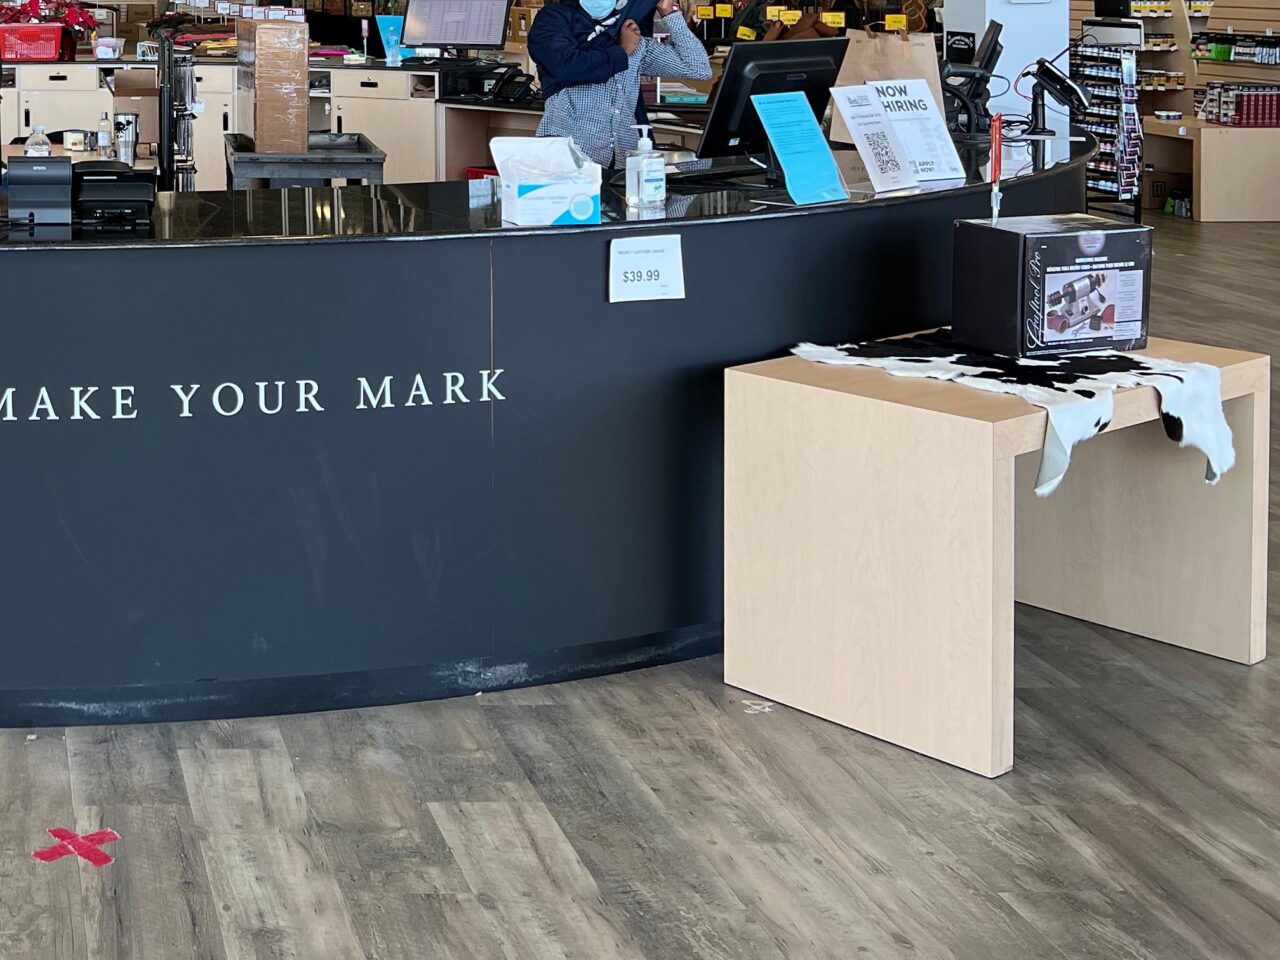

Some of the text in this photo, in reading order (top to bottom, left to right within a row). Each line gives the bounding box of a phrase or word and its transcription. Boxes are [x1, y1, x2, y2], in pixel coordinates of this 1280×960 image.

[875, 85, 908, 98] NOW
[882, 99, 928, 113] HIRING
[622, 270, 661, 284] $39.99
[170, 379, 326, 418] YOUR
[356, 368, 508, 410] MARK
